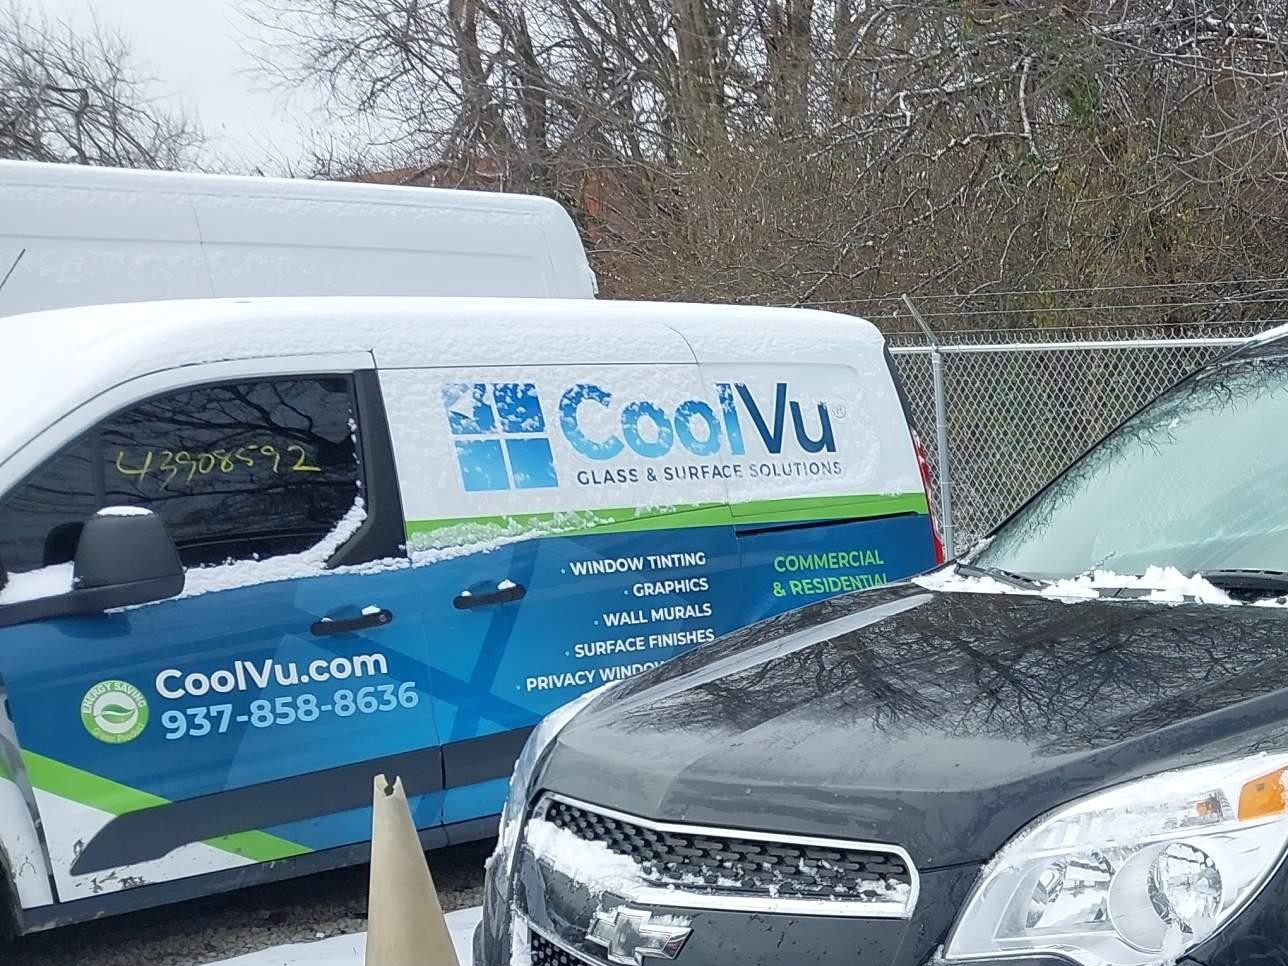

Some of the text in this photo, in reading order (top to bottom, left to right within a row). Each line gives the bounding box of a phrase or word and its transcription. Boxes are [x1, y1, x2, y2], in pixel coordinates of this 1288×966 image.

[558, 382, 837, 460] CoolVu
[116, 445, 321, 492] 43908592
[577, 461, 842, 486] GLASS & SURFACE SOLUTIONS
[570, 552, 706, 576] WINDOW TINTING
[774, 550, 885, 573] COMMERCIAL
[633, 577, 709, 597] GRAPHICS
[773, 572, 888, 597] & RESIDENTIAL
[603, 603, 712, 627] WALL MURALS
[574, 629, 715, 658] SURFACE FINISHES
[155, 652, 388, 699] CoolVu.com
[526, 669, 595, 692] PRIVACY
[83, 682, 146, 713] ENERGY SAVING
[161, 681, 419, 740] 937-858-8636
